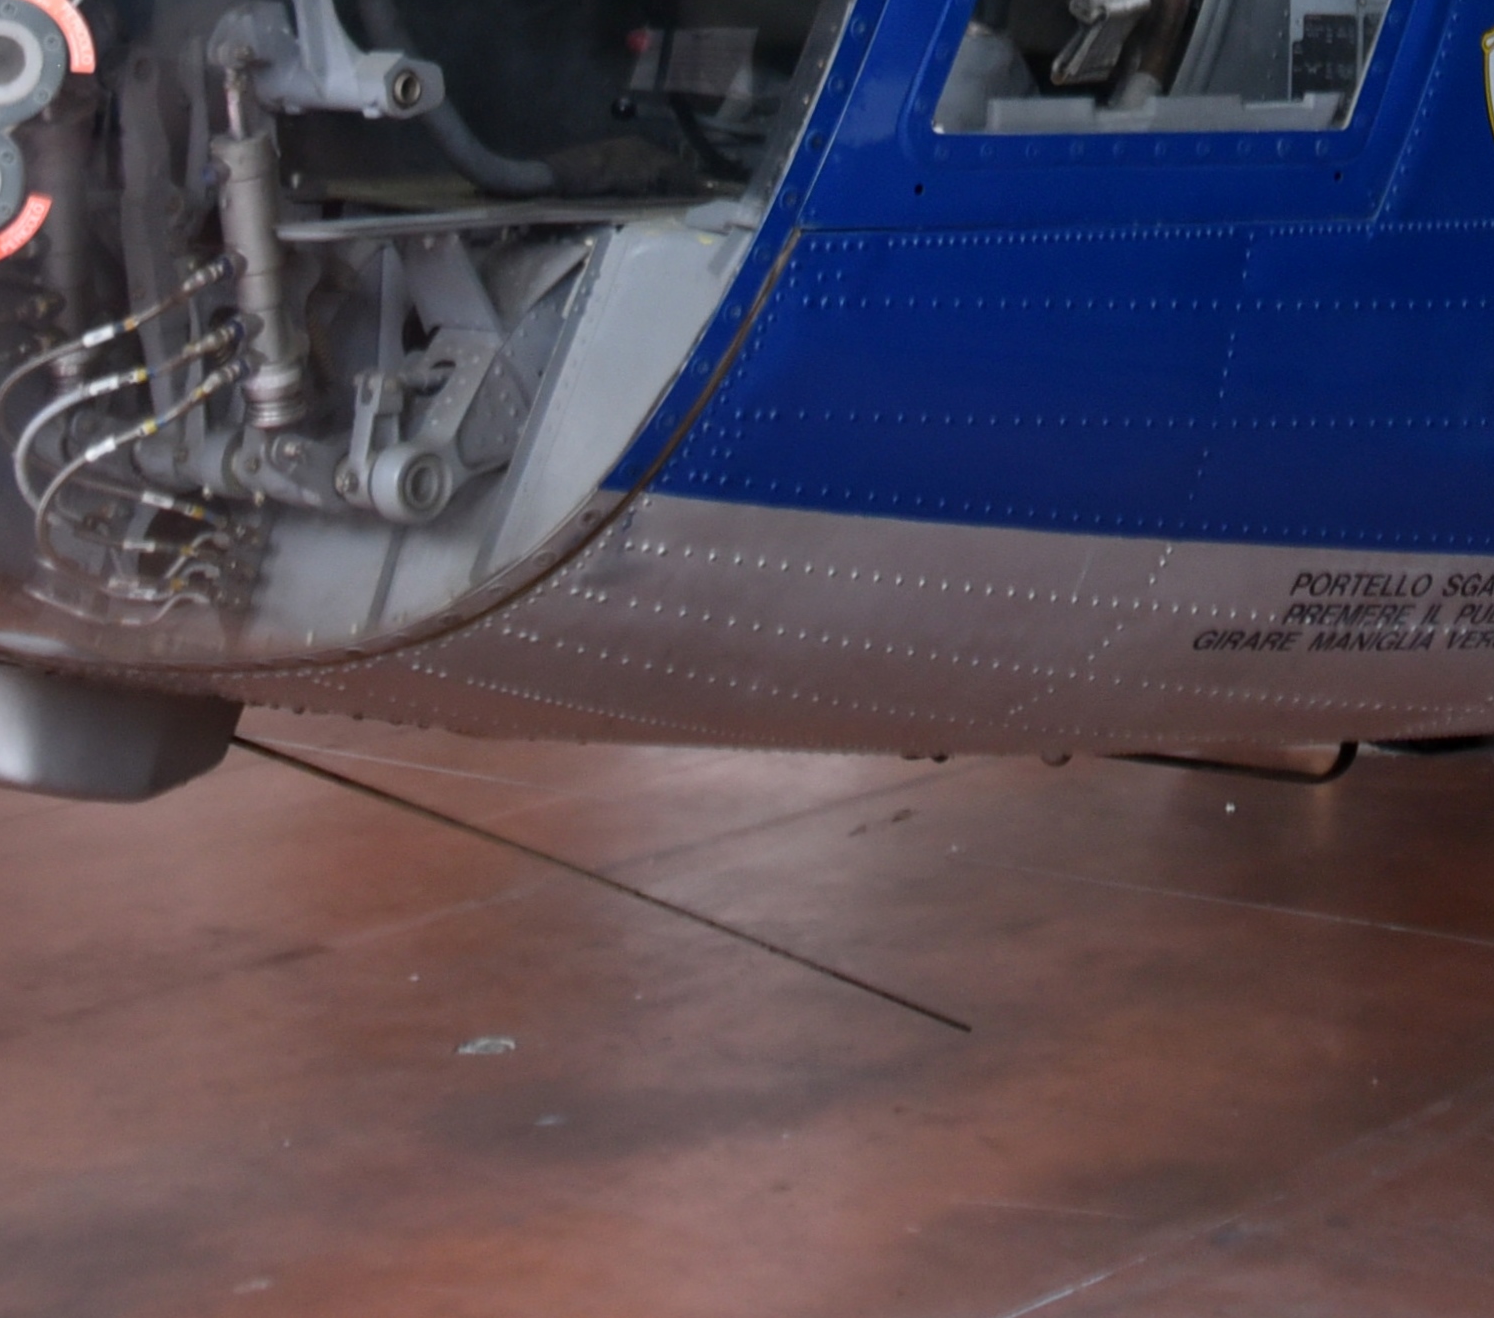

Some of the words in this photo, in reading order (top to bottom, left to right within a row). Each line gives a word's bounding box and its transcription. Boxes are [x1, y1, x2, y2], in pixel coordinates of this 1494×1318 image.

[1290, 572, 1433, 598] PORTELLO
[1282, 603, 1417, 627] PREMERE
[1420, 603, 1443, 625] IL
[1192, 628, 1304, 652] GIRARE
[1307, 629, 1436, 652] MANIGLIA
